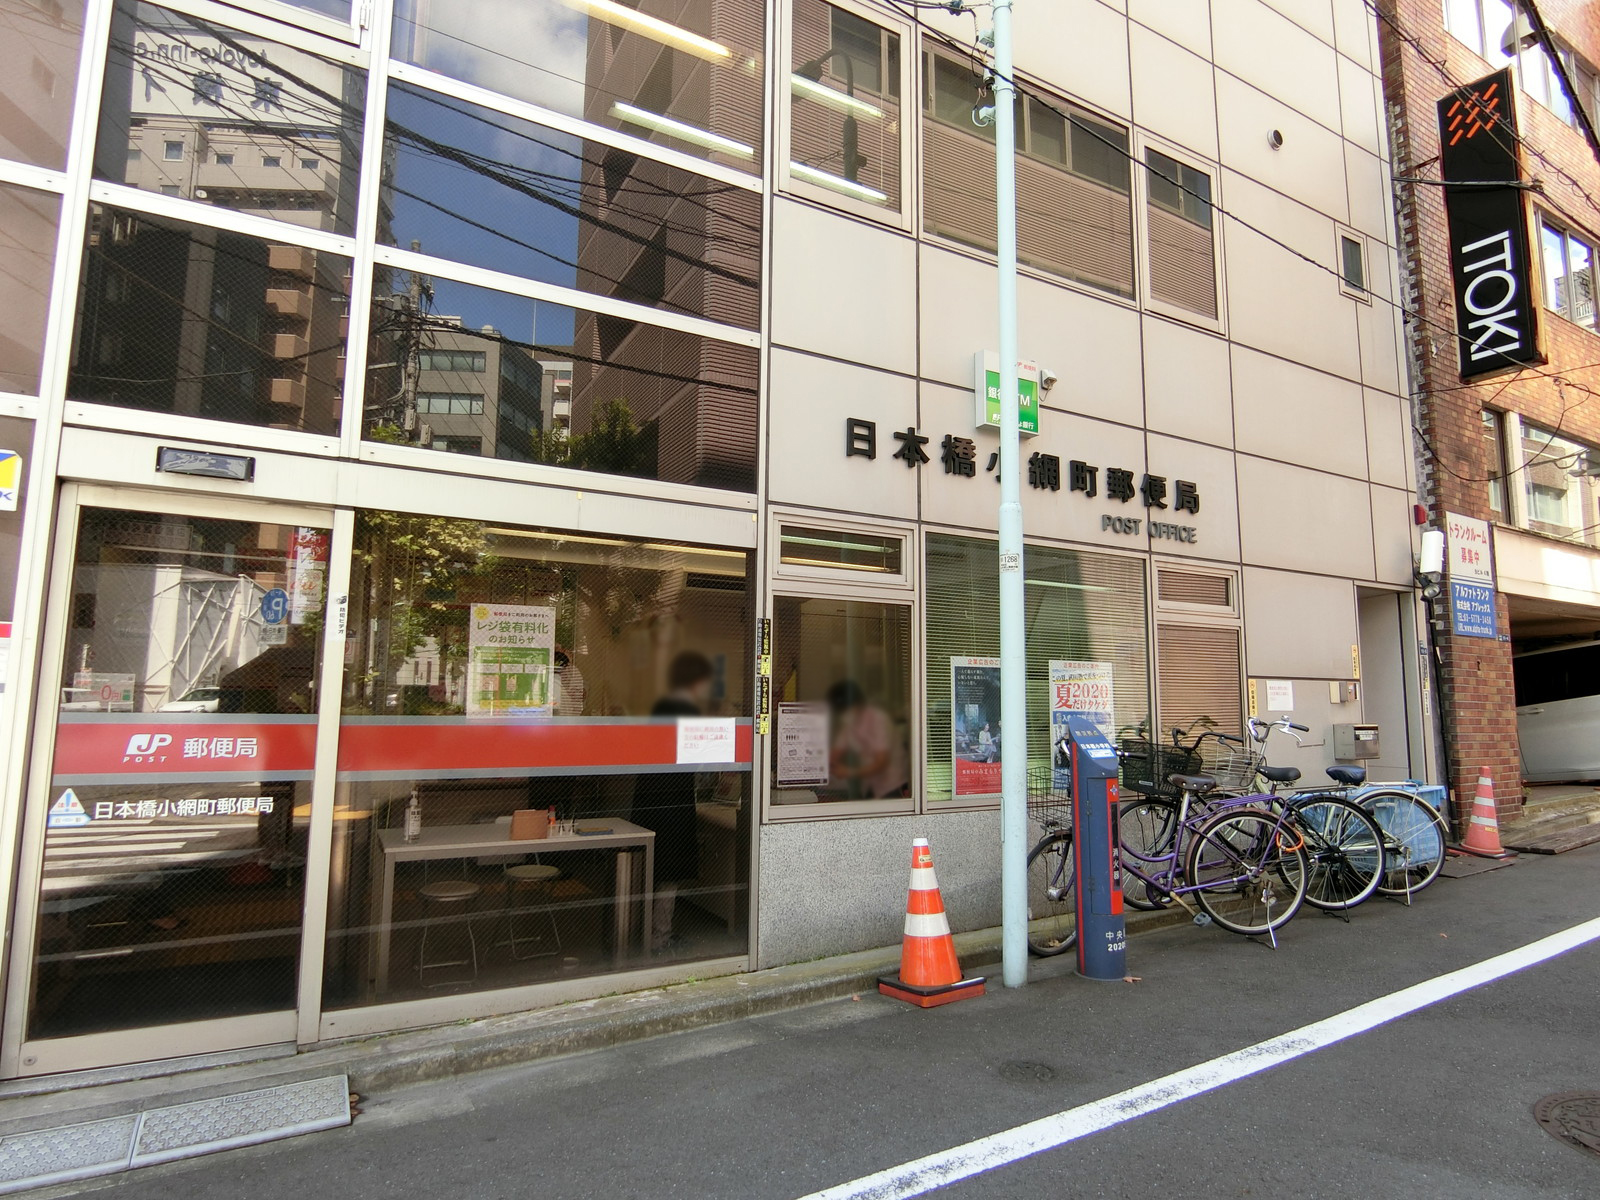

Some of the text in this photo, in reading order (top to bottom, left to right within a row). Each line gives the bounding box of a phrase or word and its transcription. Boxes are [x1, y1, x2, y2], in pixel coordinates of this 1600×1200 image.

[1461, 230, 1522, 361] ITOKI
[1101, 514, 1198, 544] POST OFFICE
[1449, 522, 1488, 545] トランクルーム
[1461, 547, 1480, 566] 募集中
[476, 620, 550, 635] レジ袋有料化
[488, 635, 536, 645] のお知らせ
[1054, 682, 1109, 709] 夏 2020
[183, 737, 258, 758] 郵便局
[122, 755, 168, 763] POST
[94, 796, 274, 820] 日本橋小網町郵便局
[1105, 928, 1126, 942] 中央
